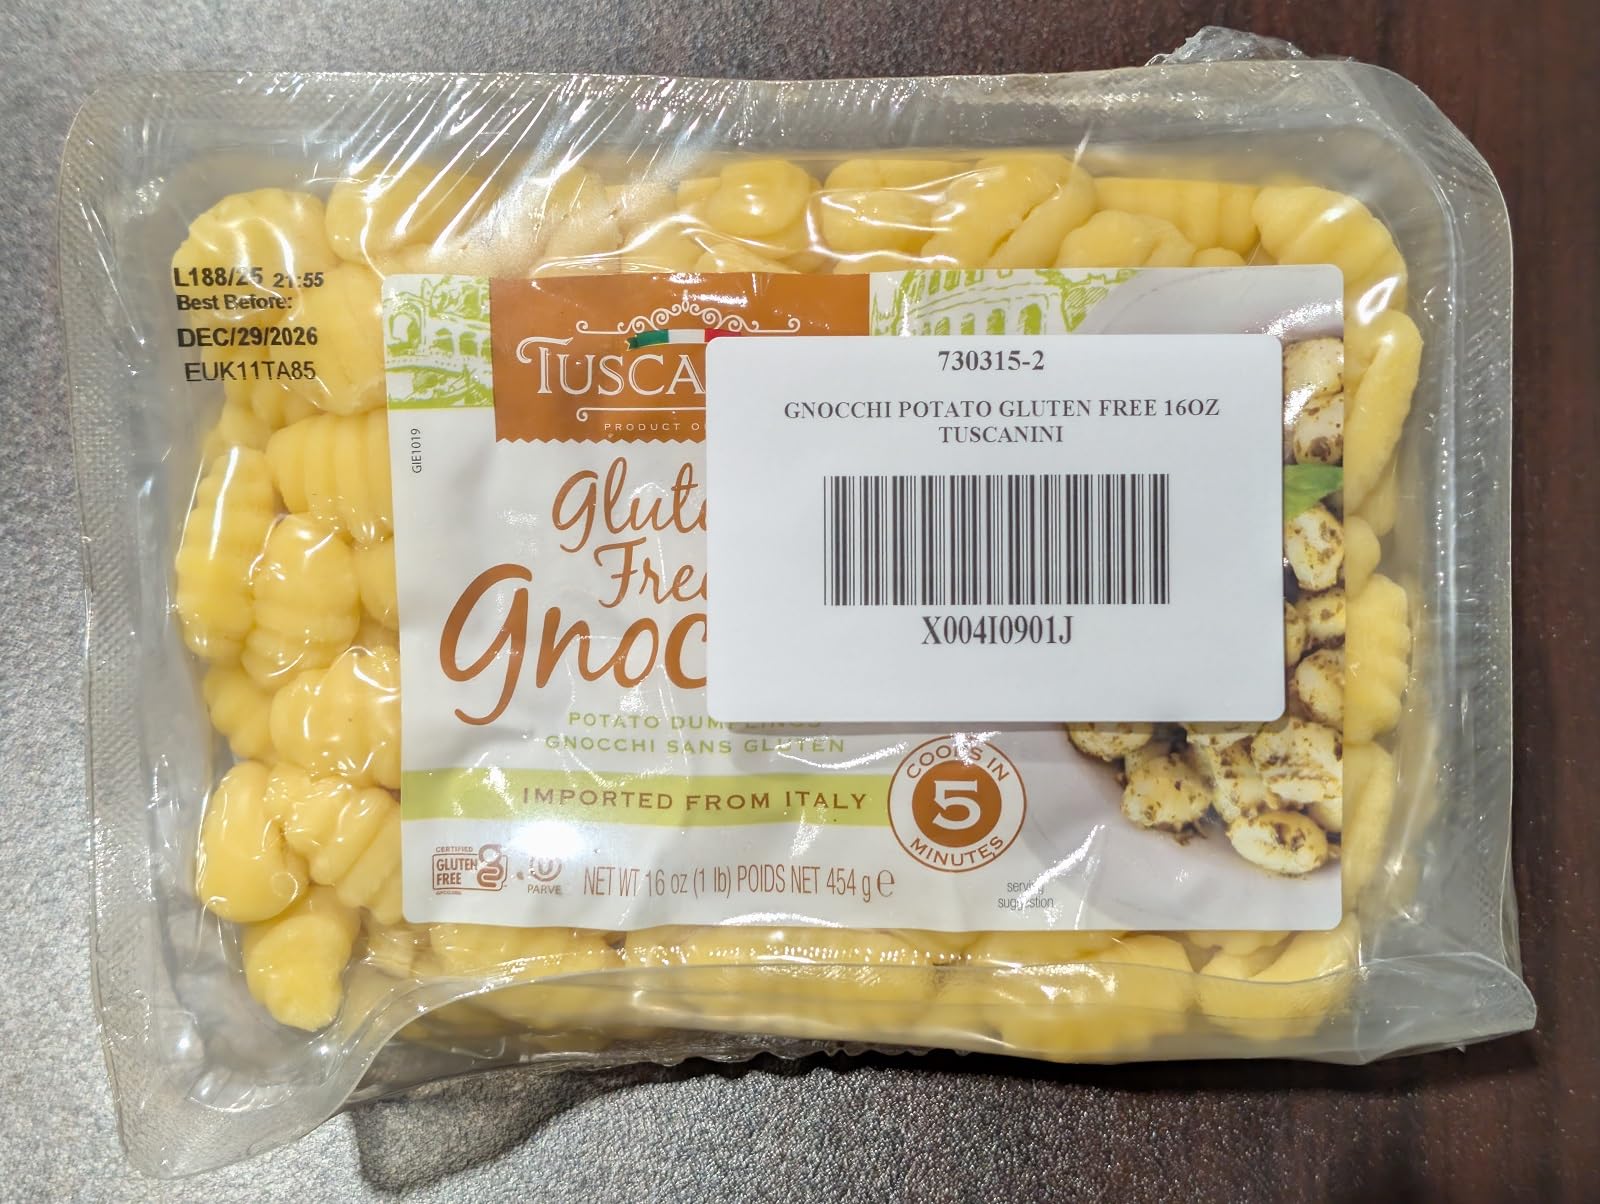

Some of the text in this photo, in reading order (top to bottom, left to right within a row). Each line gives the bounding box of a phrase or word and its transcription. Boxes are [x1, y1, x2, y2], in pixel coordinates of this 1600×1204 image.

[173, 267, 324, 288] L188/25 21:55
[176, 294, 292, 310] Best Before:
[177, 326, 318, 347] DEC/29/2026
[937, 349, 1045, 371] 730315-2
[184, 360, 316, 382] EUK11TA85
[784, 399, 1220, 419] GNOCCHI POTATO GLUTEN FREE 16OZ
[604, 423, 680, 431] PRODUCT
[938, 425, 1064, 443] TUSCANINI
[410, 428, 422, 473] GIE1019
[593, 537, 706, 608] Fre
[921, 615, 1074, 645] X004I0901J
[569, 712, 659, 729] POTATO
[545, 735, 844, 753] GNOCCHI SANS GLUTEN
[987, 757, 1010, 781] IN
[523, 787, 866, 810] IMPORTED FROM ITALY
[932, 780, 981, 830] 5
[910, 836, 1004, 866] MINUTES
[436, 858, 478, 871] GLUTEN
[436, 872, 462, 885] FREE
[584, 866, 616, 895] NET
[619, 867, 641, 896] WT
[645, 868, 665, 896] 16
[671, 873, 688, 894] oz
[737, 864, 786, 893] POIDS
[791, 865, 821, 894] NET
[826, 867, 857, 896] 454
[527, 884, 562, 895] PARVE
